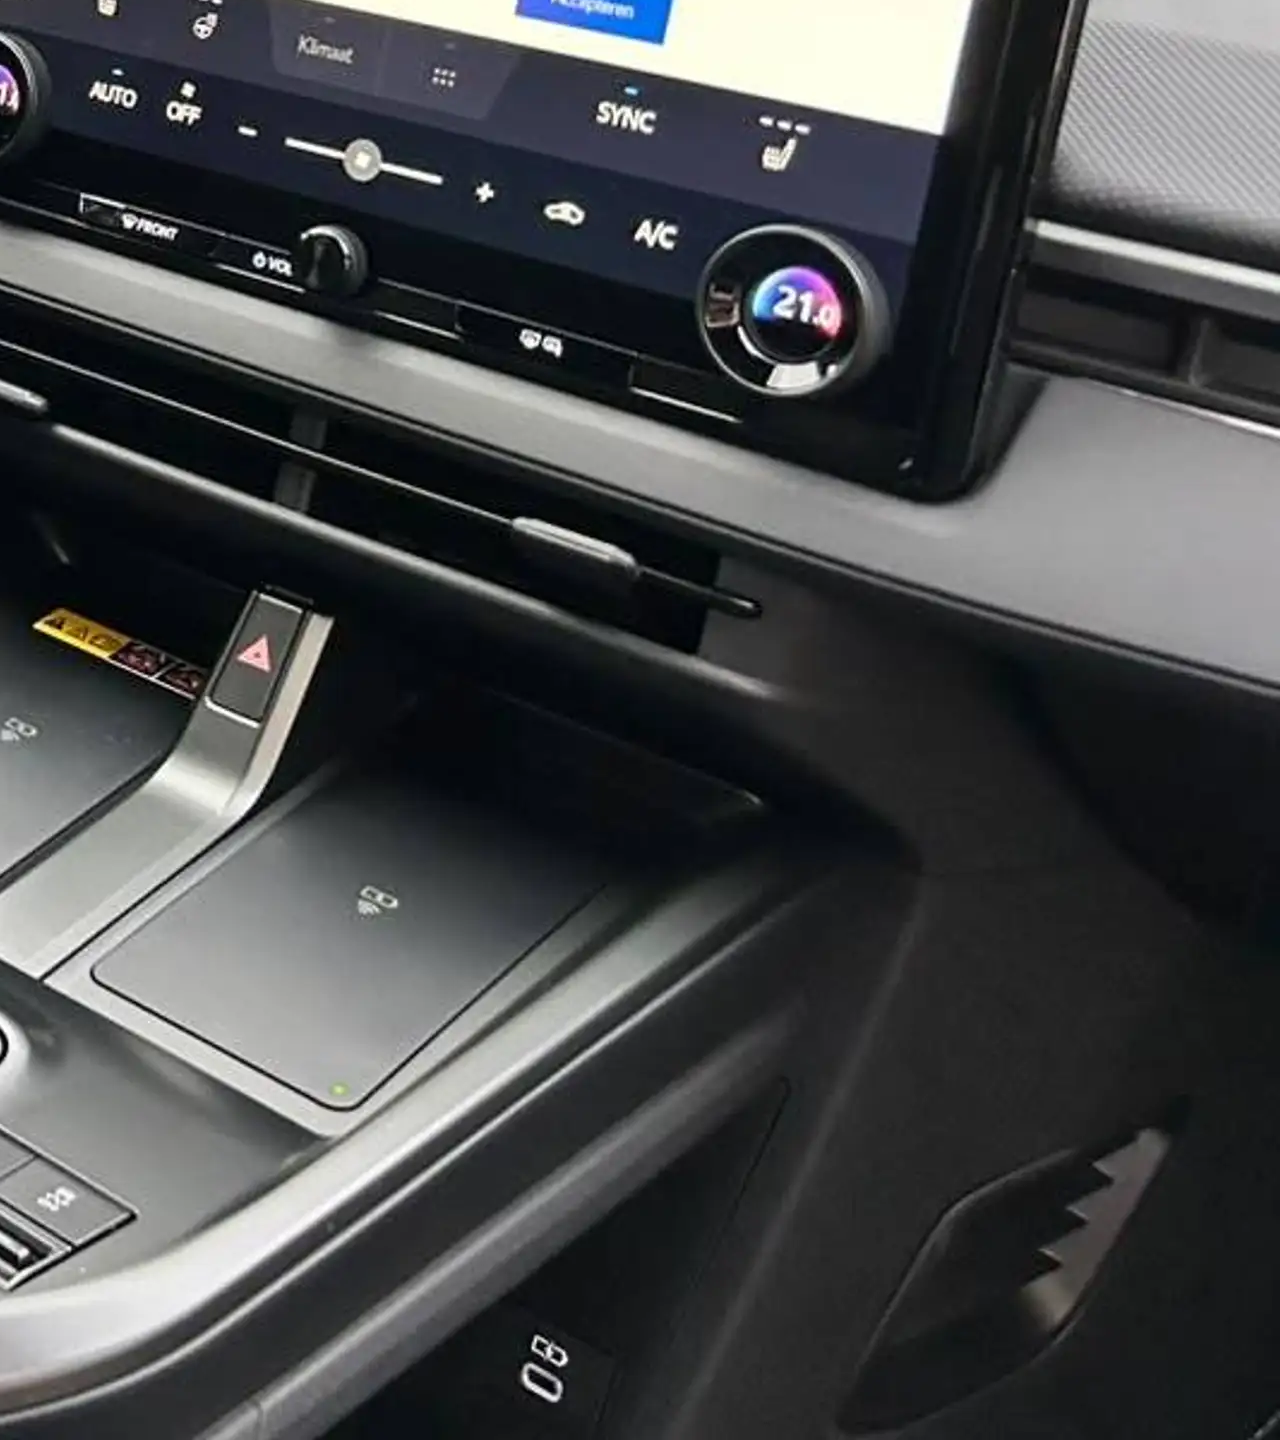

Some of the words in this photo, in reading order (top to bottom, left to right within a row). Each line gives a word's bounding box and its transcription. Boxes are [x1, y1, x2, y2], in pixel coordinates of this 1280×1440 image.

[296, 33, 355, 65] Klimaat
[88, 80, 138, 109] AUTO
[165, 100, 203, 126] OFF
[595, 100, 658, 135] SYNC
[136, 216, 180, 242] FRONT
[633, 218, 679, 250] A/C
[268, 255, 293, 277] VOL
